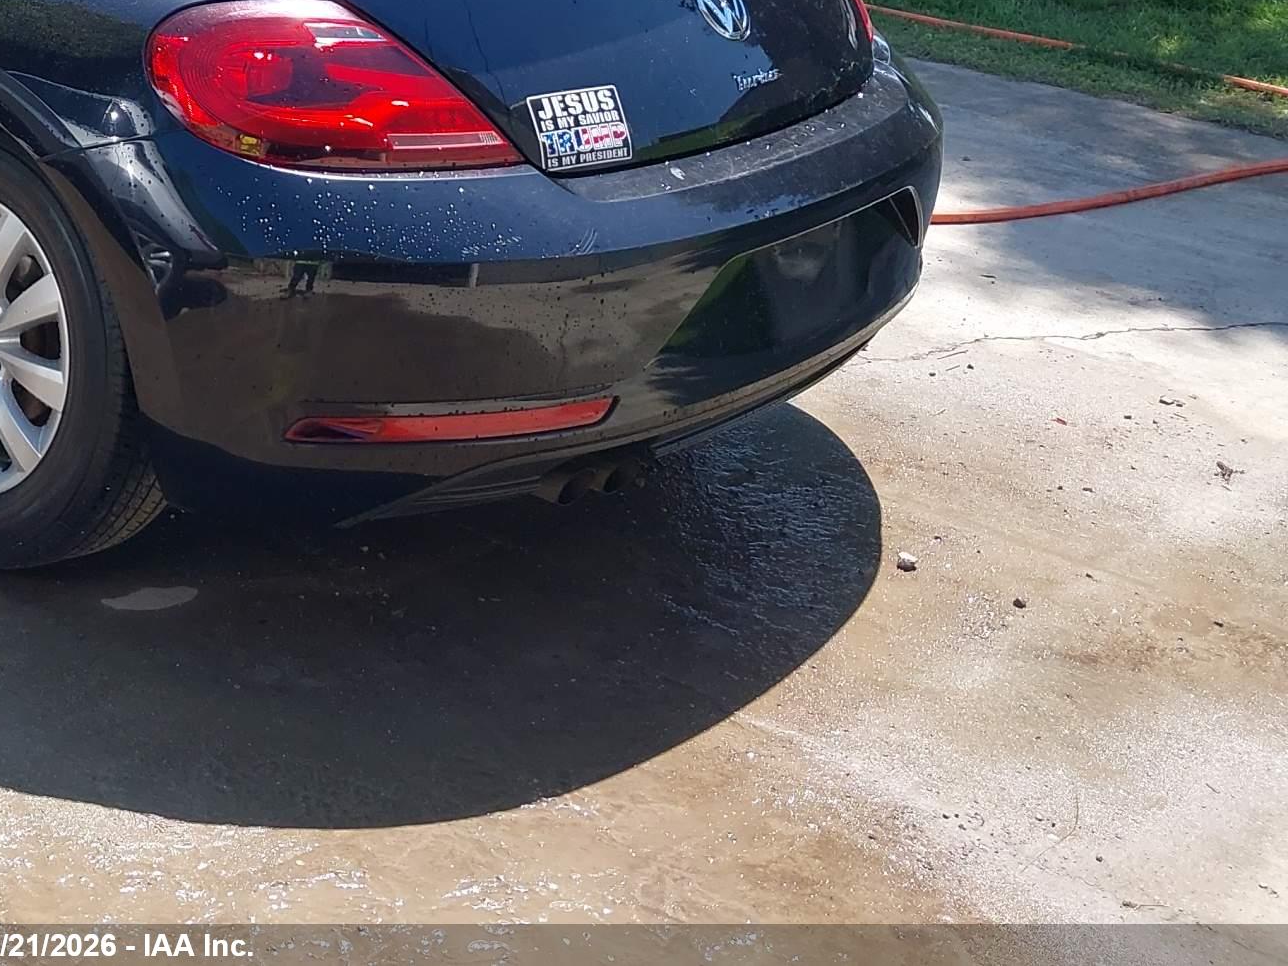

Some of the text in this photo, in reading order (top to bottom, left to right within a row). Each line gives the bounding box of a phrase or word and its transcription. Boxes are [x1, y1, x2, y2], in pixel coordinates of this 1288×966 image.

[538, 89, 616, 121] JESUS
[540, 110, 620, 132] IS MY SAVIOR
[541, 121, 628, 158] TRUMP
[547, 147, 628, 168] IS MY PRESIDENT
